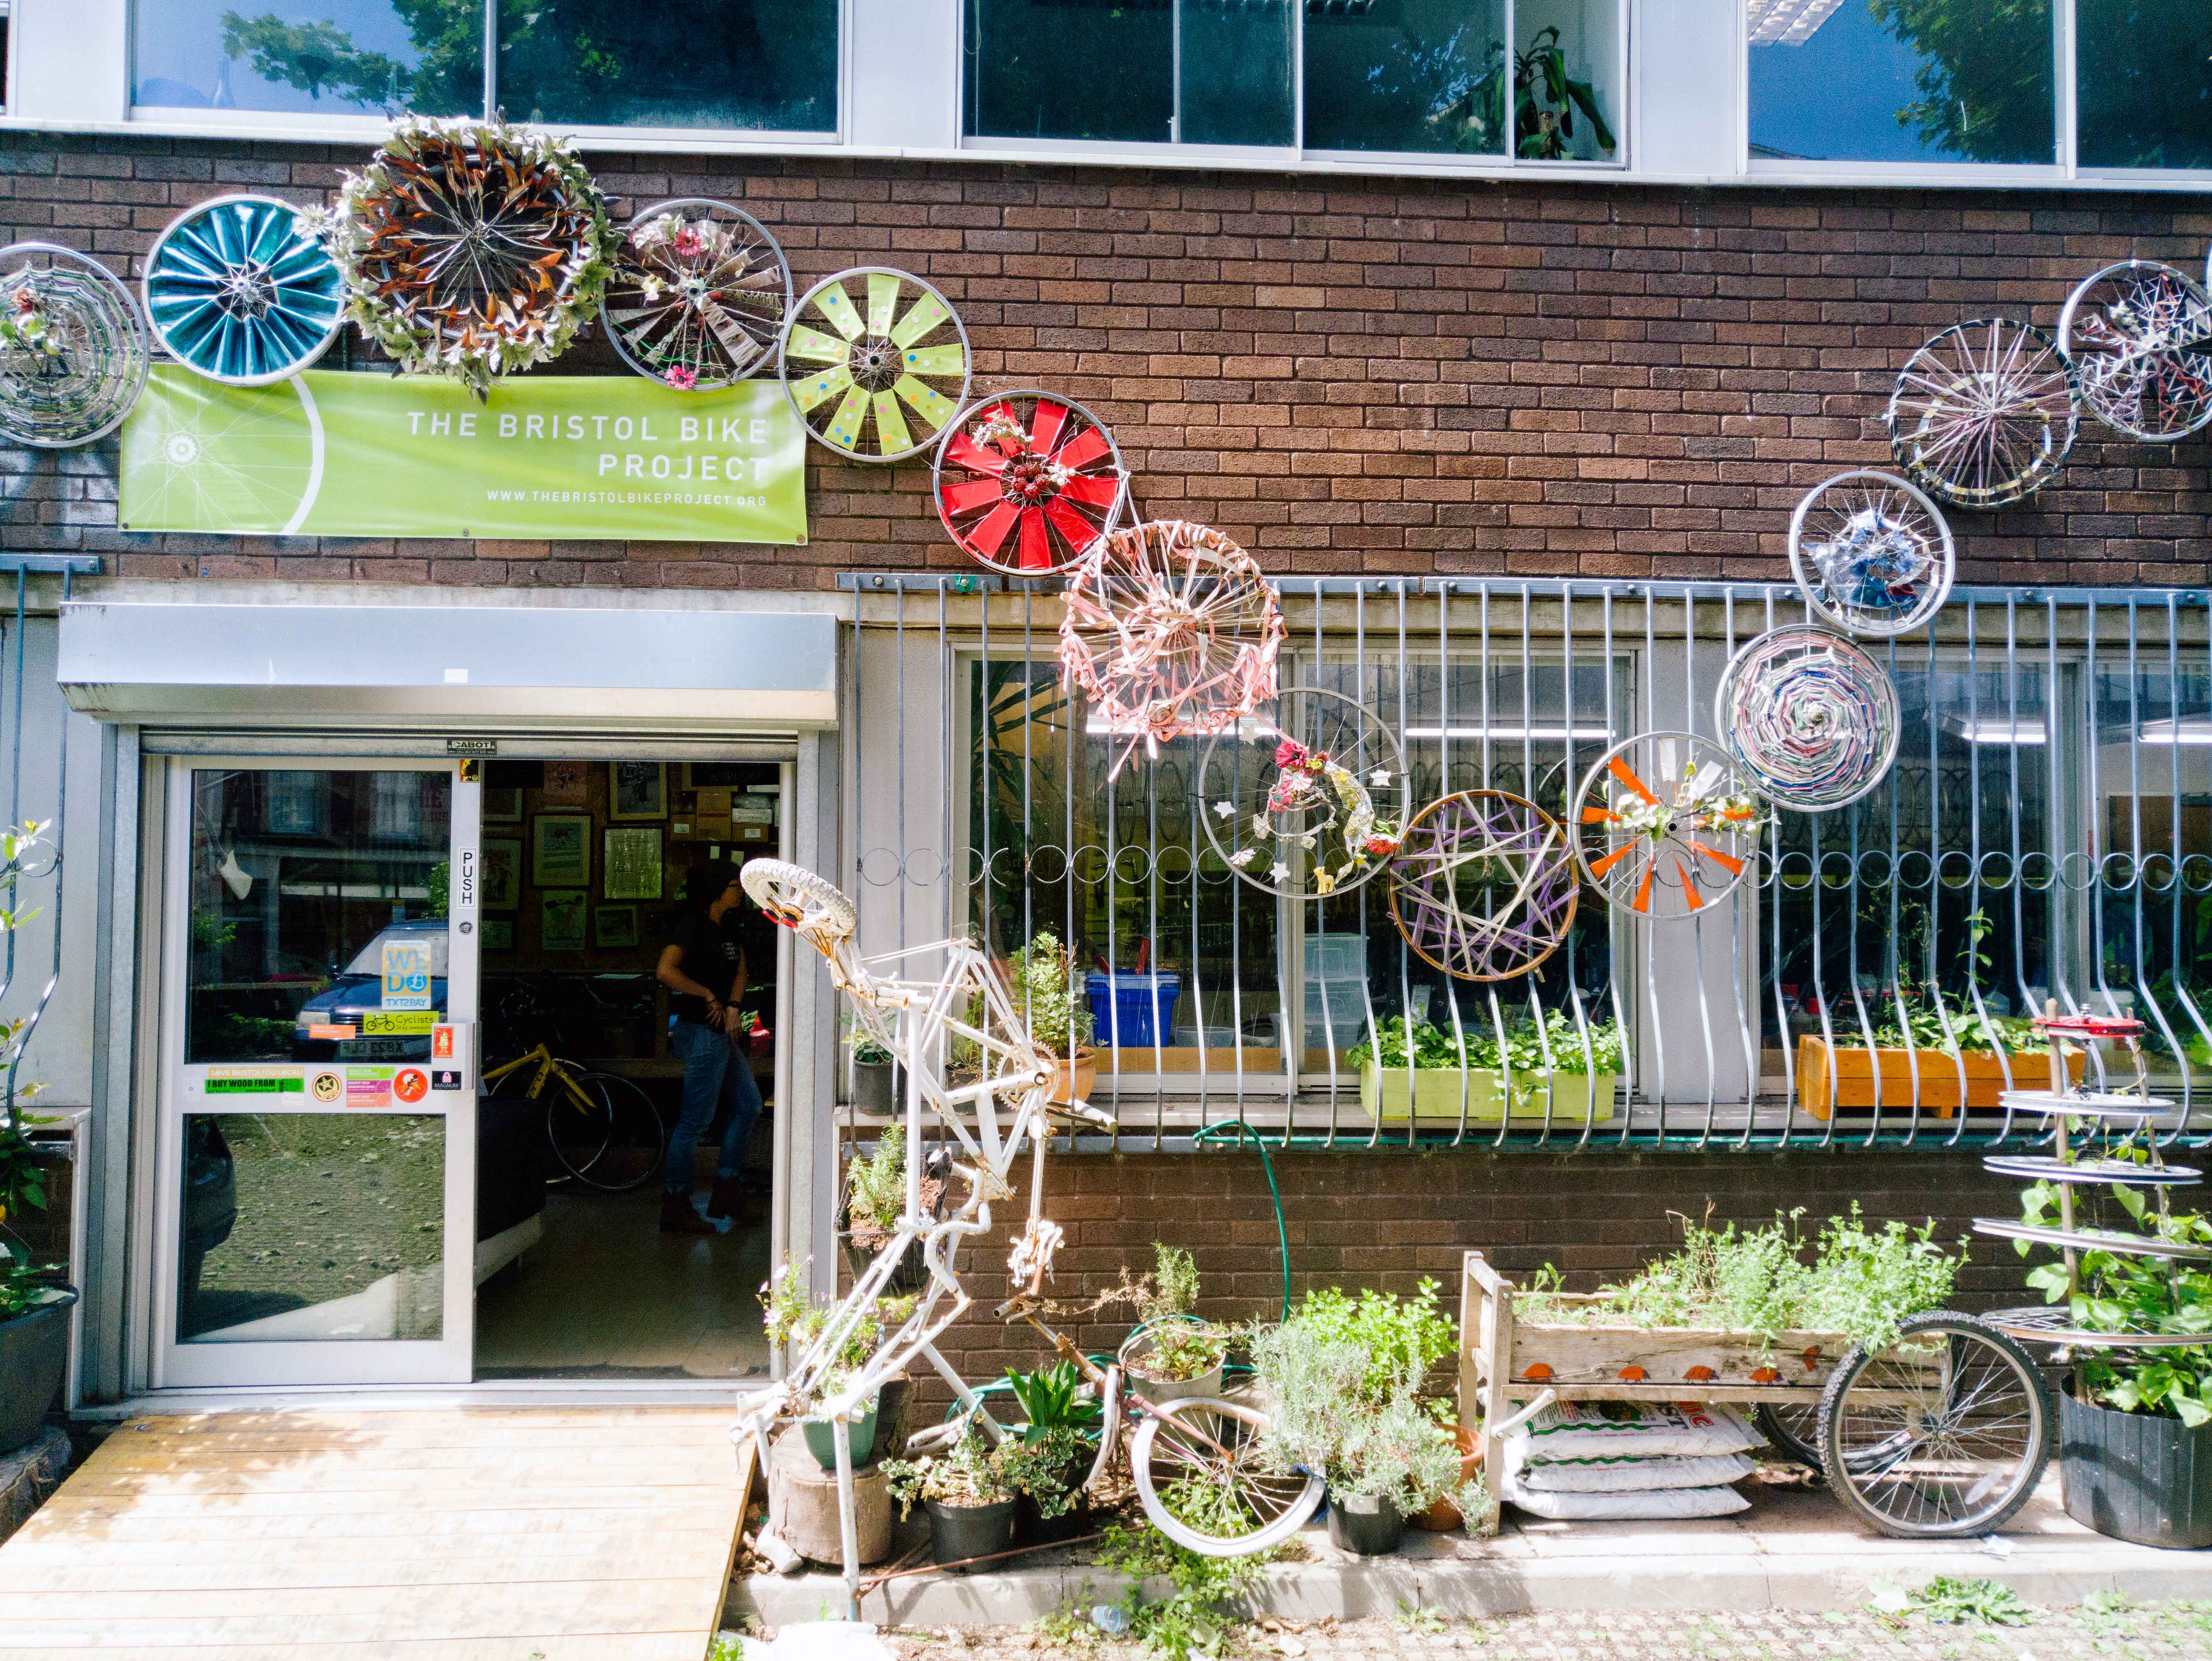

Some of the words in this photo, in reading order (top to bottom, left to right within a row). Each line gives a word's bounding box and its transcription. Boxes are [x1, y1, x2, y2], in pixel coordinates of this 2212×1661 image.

[407, 412, 477, 436] THE
[499, 414, 658, 441] BRISTOL
[681, 417, 767, 444] BIKE
[599, 454, 769, 481] PROJECT
[487, 490, 766, 507] WWW.THEBRISTOLBIKEPROJECT.ORG
[462, 853, 473, 904] PUSH
[386, 950, 428, 970] WE
[386, 998, 427, 1007] TXT2PAY
[396, 1015, 434, 1025] Cyclists
